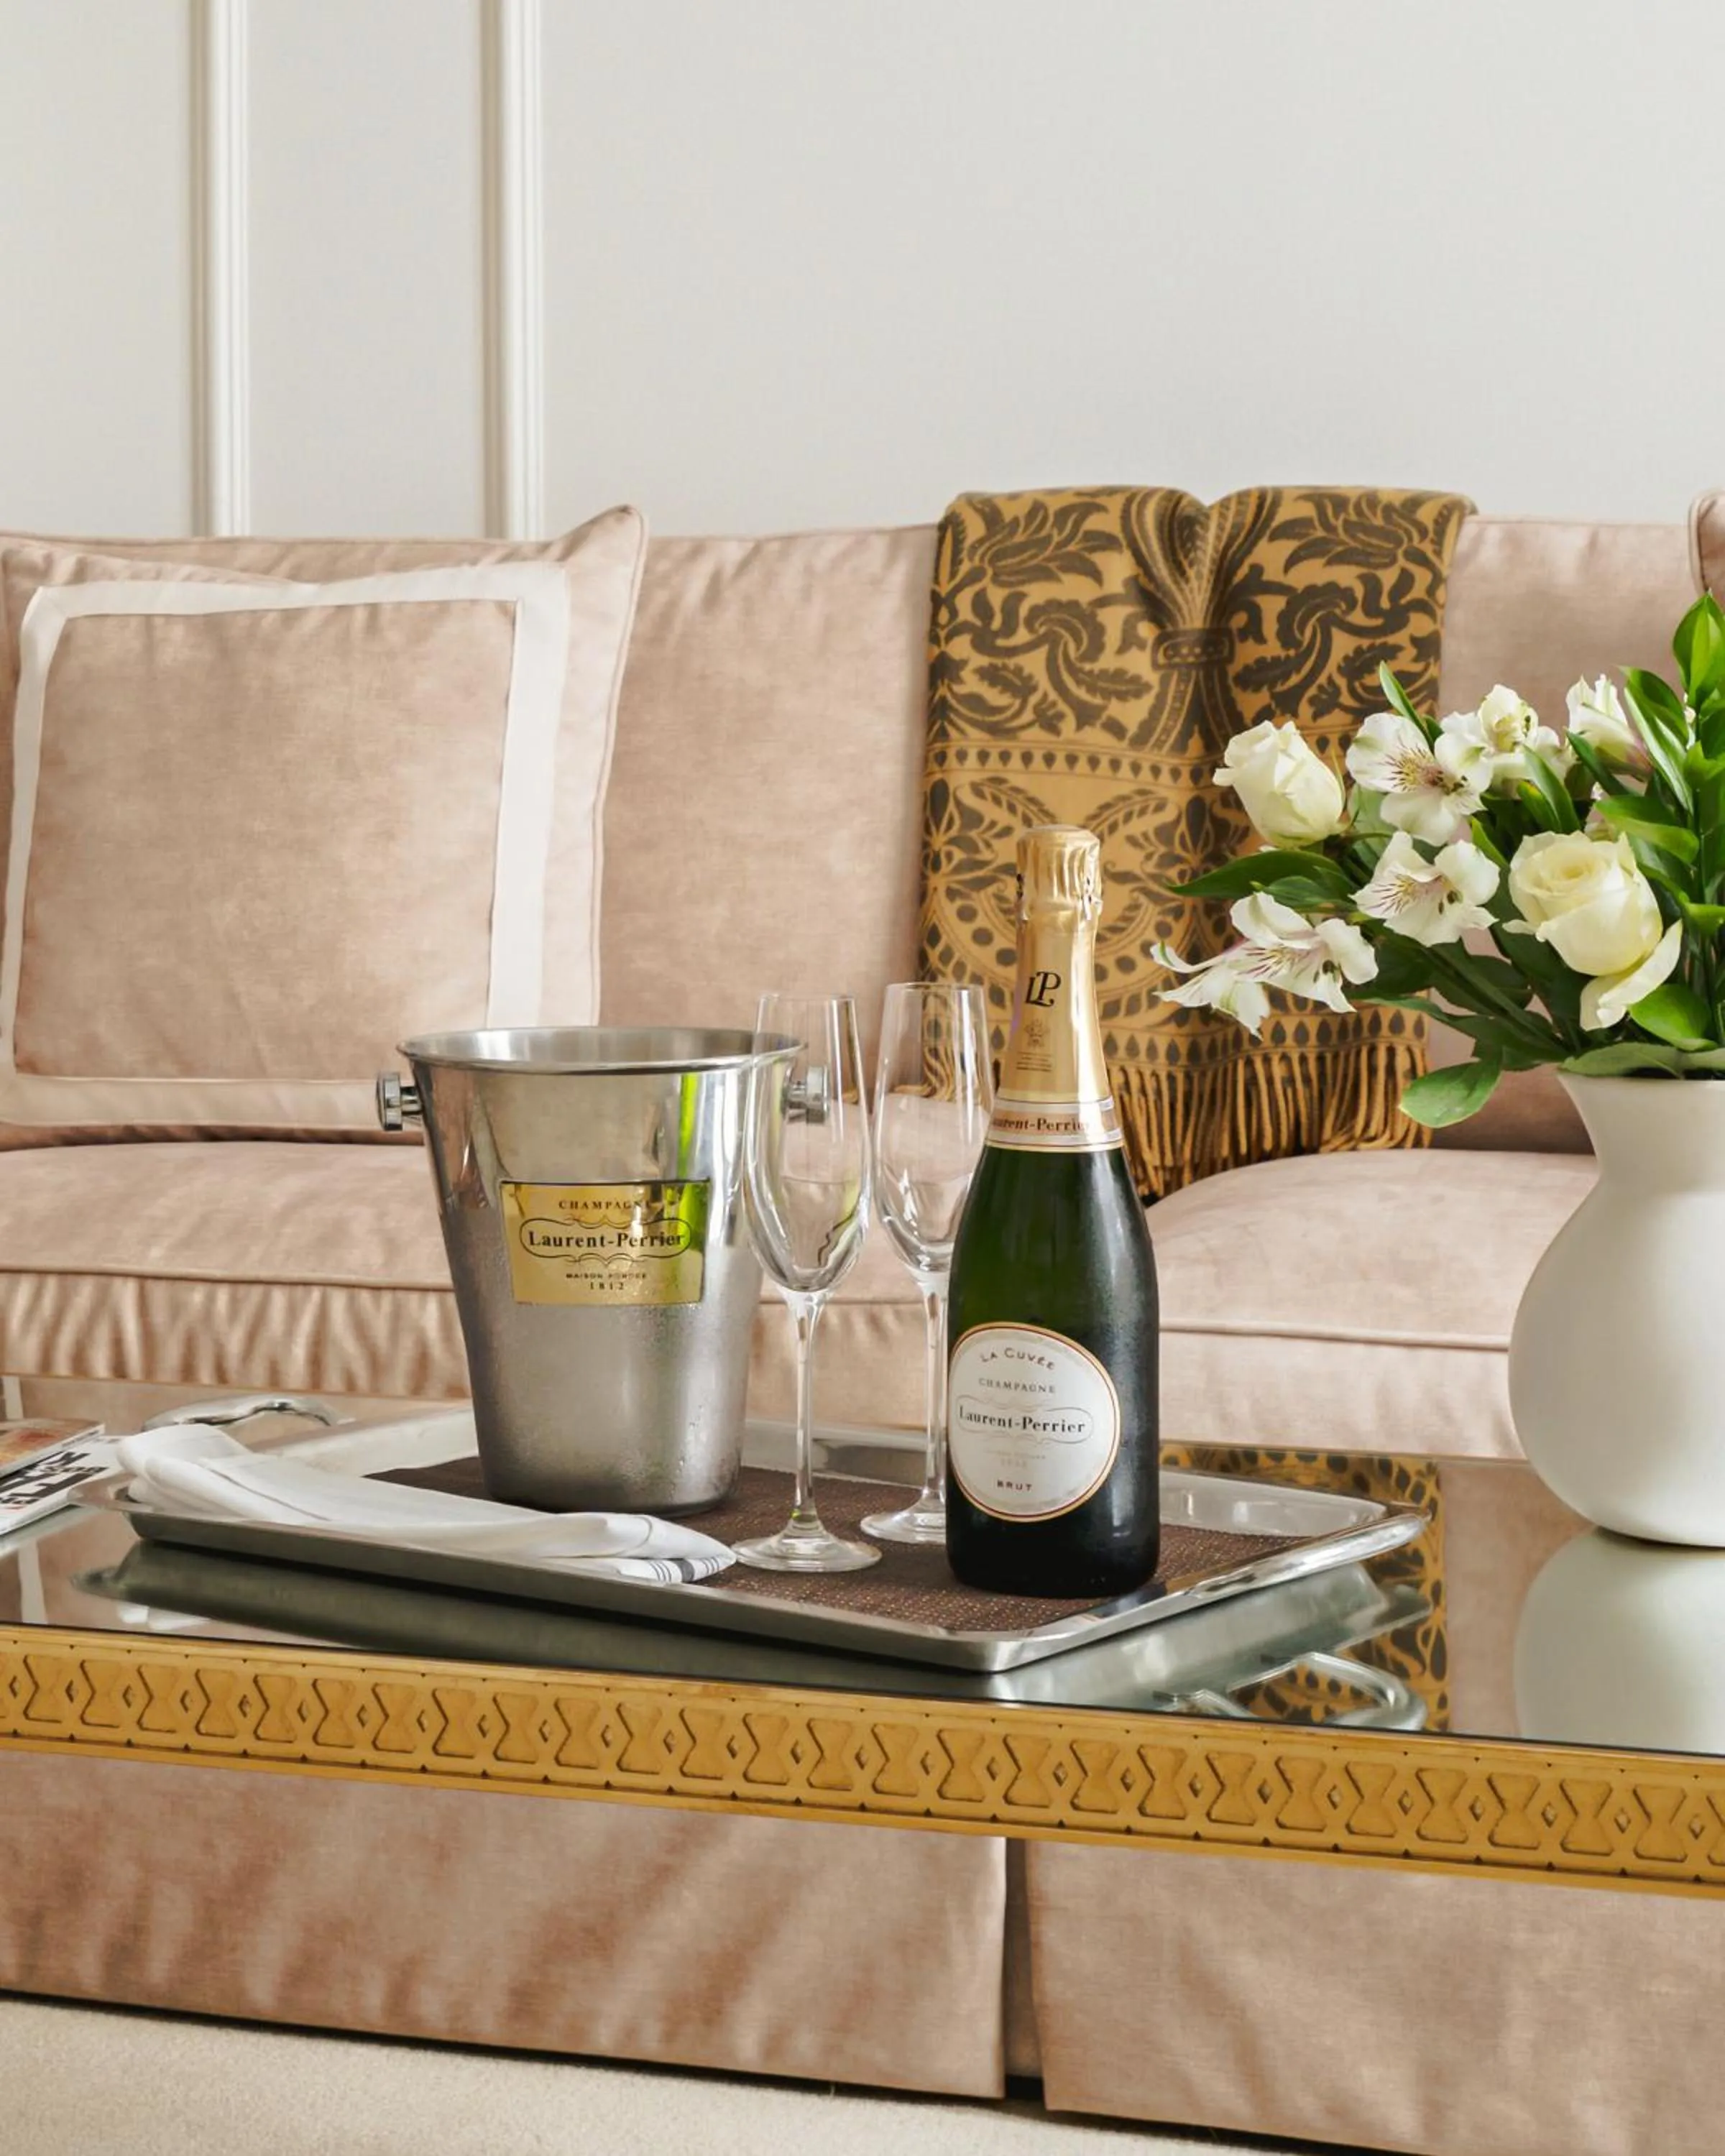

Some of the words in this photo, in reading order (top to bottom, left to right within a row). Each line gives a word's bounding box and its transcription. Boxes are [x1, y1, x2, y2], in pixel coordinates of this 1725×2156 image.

[528, 1230, 685, 1248] Laurent-Perrier
[979, 1351, 998, 1363] LA
[978, 1378, 1056, 1393] CHAMPAGNE
[959, 1404, 1086, 1433] Laurent-Perrier
[997, 1479, 1033, 1491] BRUT
